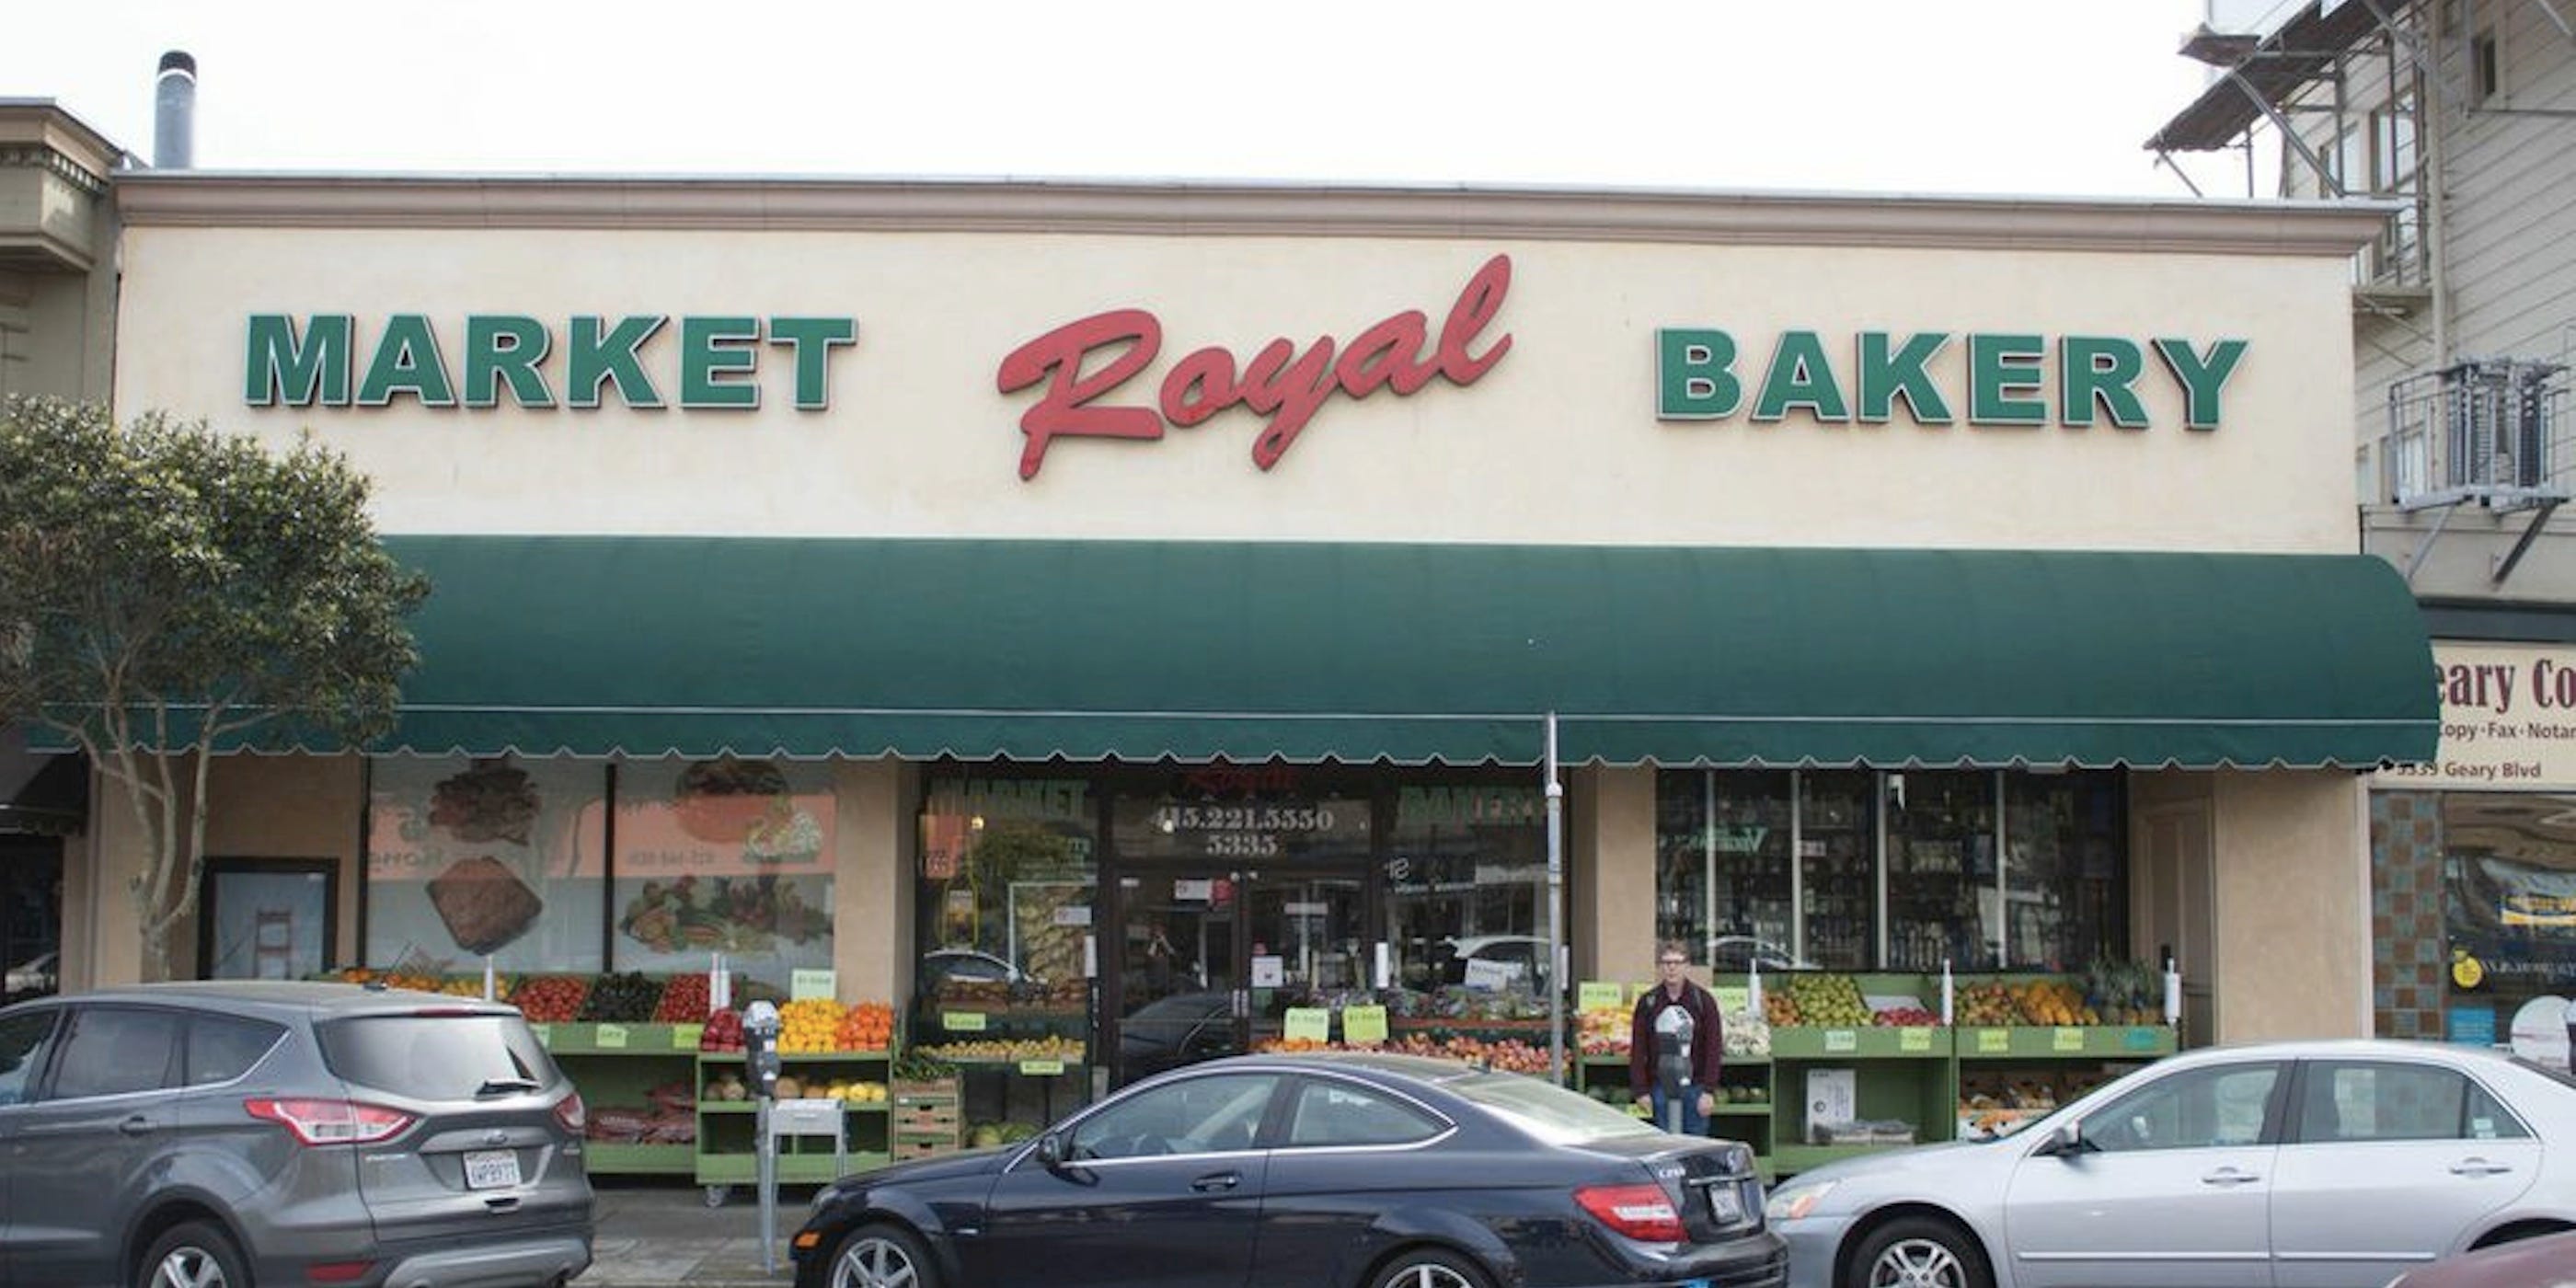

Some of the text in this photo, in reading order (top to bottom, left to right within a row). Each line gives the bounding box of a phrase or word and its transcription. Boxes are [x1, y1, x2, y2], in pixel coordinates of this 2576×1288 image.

[243, 313, 857, 412] MARKET
[996, 253, 1513, 482] Royal
[1654, 327, 2250, 431] BAKERY
[2444, 762, 2497, 781] Geary
[2502, 762, 2542, 778] Blvd
[1205, 834, 1279, 856] 5335
